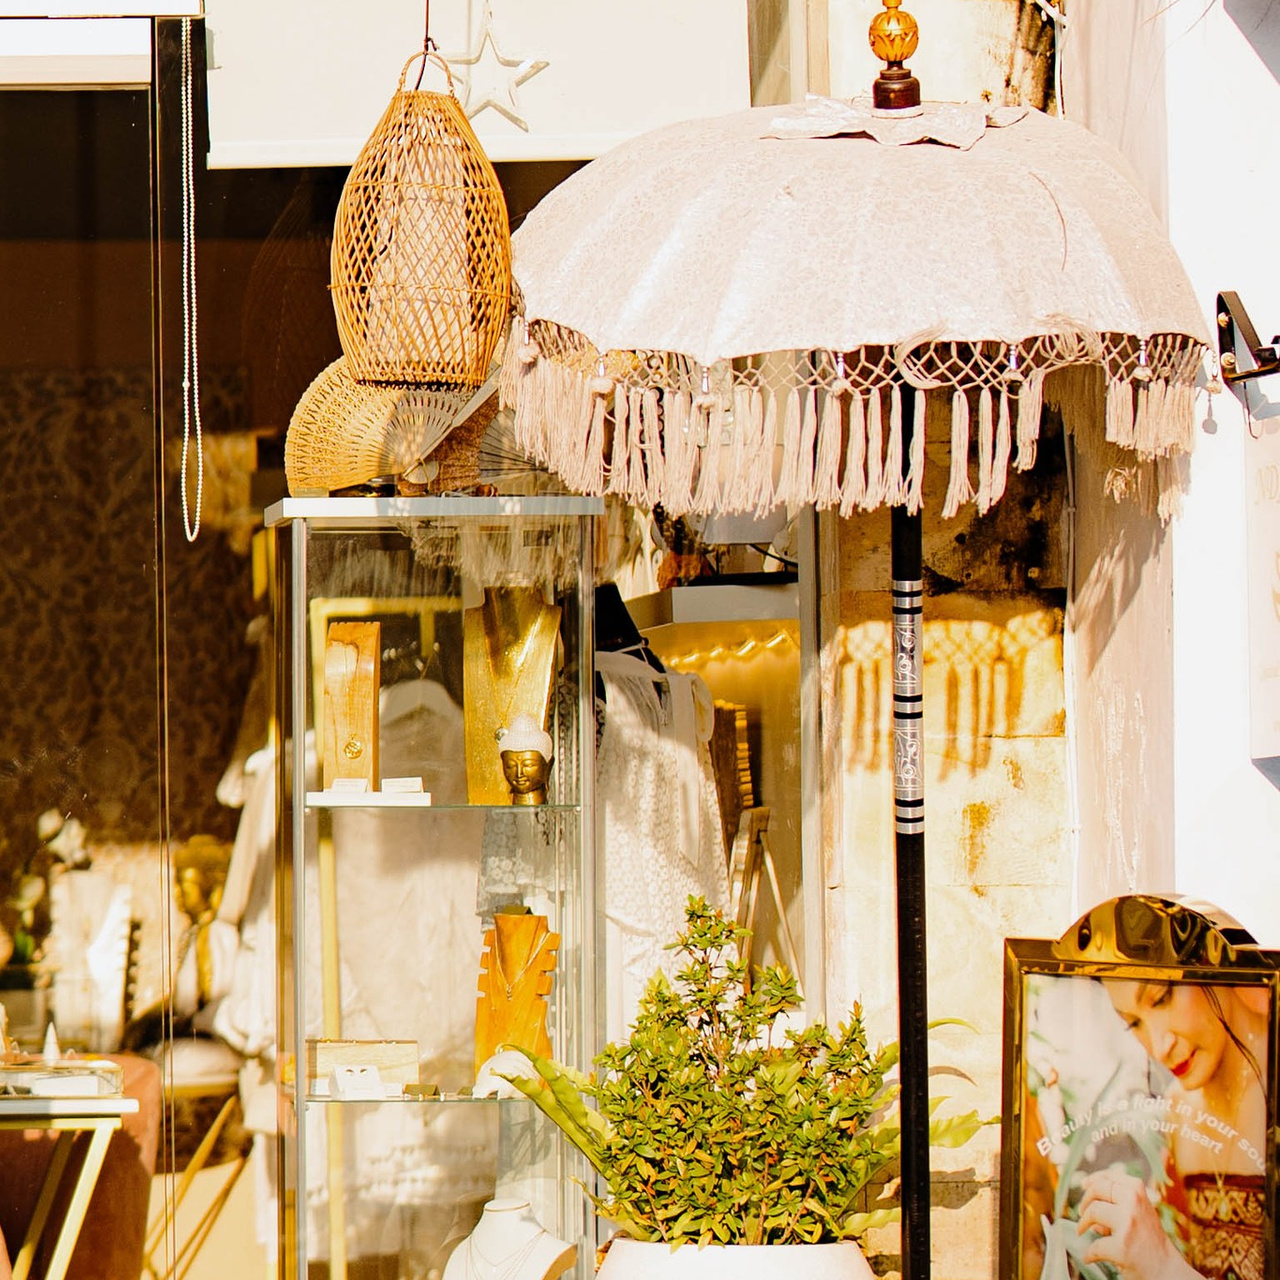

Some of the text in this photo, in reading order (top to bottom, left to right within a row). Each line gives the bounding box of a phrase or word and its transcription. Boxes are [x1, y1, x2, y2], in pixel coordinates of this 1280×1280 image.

[1091, 1120, 1119, 1142] and
[1141, 1119, 1178, 1135] your
[1180, 1123, 1224, 1154] heart
[1175, 1100, 1193, 1116] in
[1195, 1111, 1238, 1139] your
